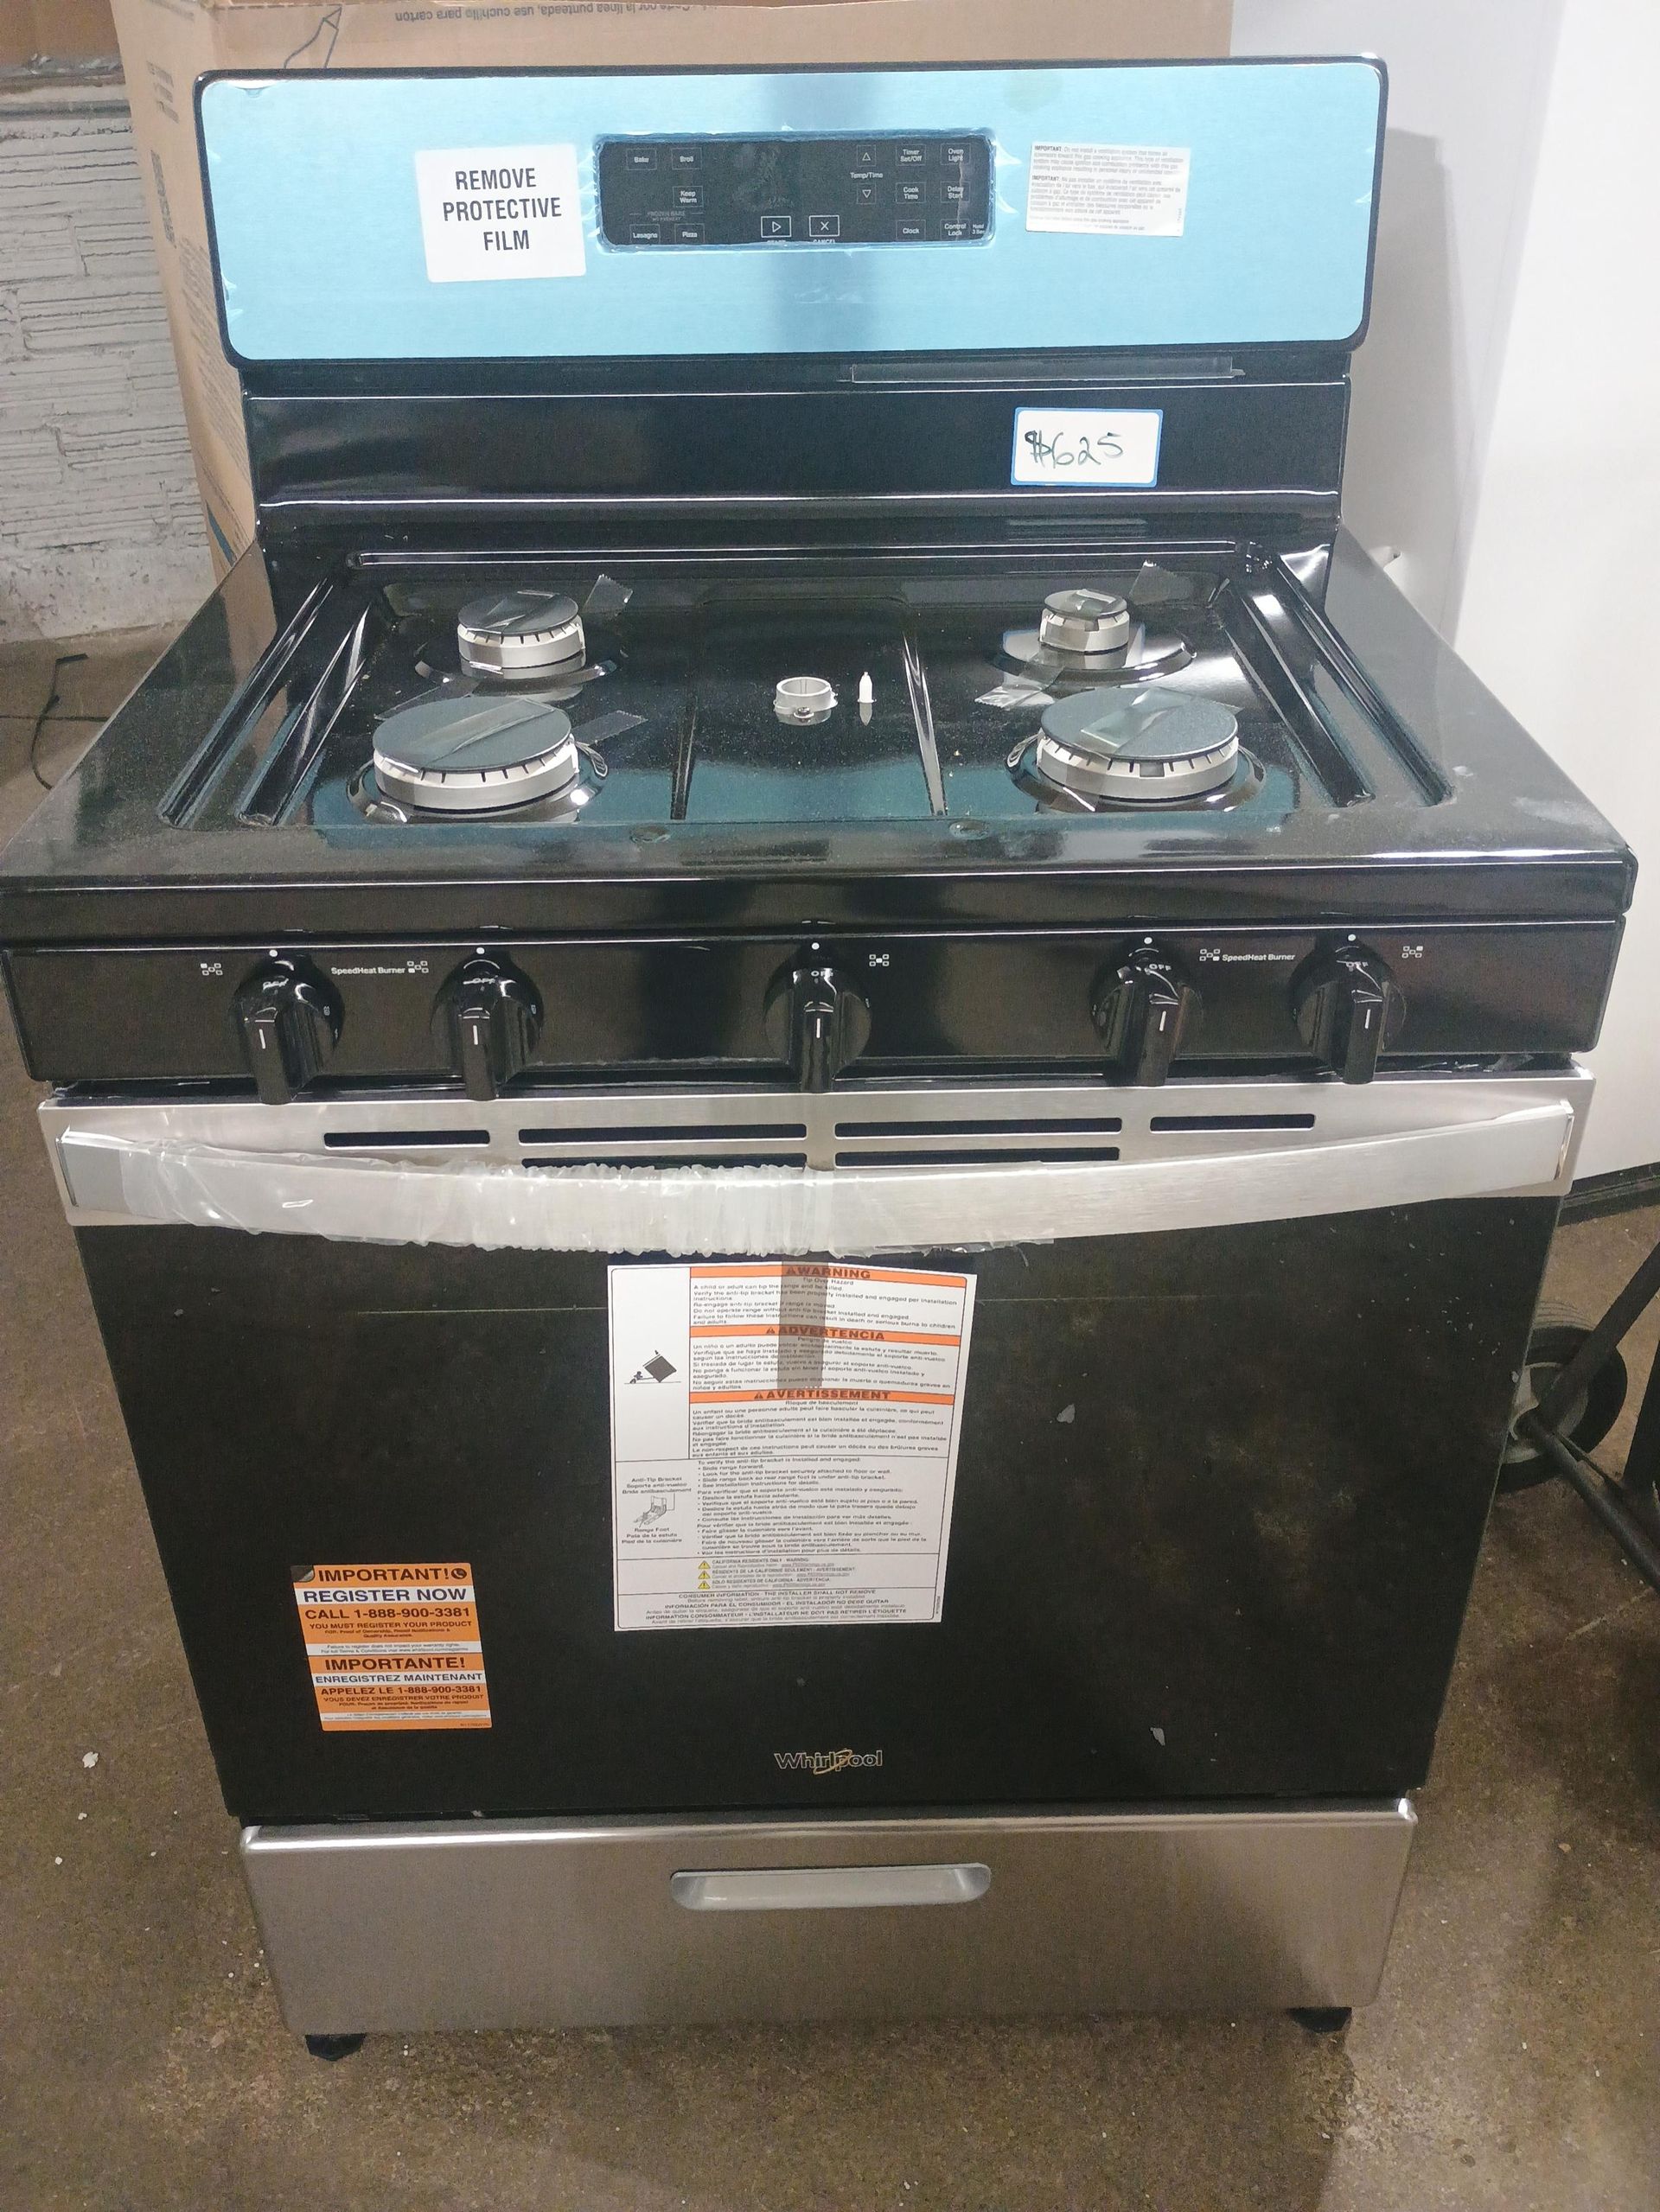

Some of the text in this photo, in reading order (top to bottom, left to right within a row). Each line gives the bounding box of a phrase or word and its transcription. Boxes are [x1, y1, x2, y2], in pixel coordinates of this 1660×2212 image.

[395, 11, 432, 22] carton
[437, 7, 462, 20] para
[465, 8, 510, 21] cuchillo
[514, 7, 534, 16] use
[455, 167, 536, 190] REMOVE
[443, 196, 562, 222] PROTECTIVE
[483, 229, 530, 252] FILM
[1024, 430, 1124, 468] $625
[1222, 953, 1265, 962] SpeedHeat
[331, 966, 375, 975] SpeedHeat
[798, 1266, 871, 1278] WARNING
[779, 1327, 884, 1339] ADVERTENCIA
[767, 1390, 891, 1399] AVERTISSEMENT
[319, 1568, 449, 1582] IMPORTANT!
[303, 1589, 466, 1603] REGISTER NOW
[305, 1607, 469, 1619] CALL 1-888-900-3381
[325, 1657, 464, 1670] IMPORTANTE!
[316, 1674, 400, 1683] ENREGISTREZ
[322, 1686, 374, 1695] APPELEZ
[398, 1686, 481, 1694] 1-888-900-3381
[774, 1750, 883, 1771] Whirlpool
